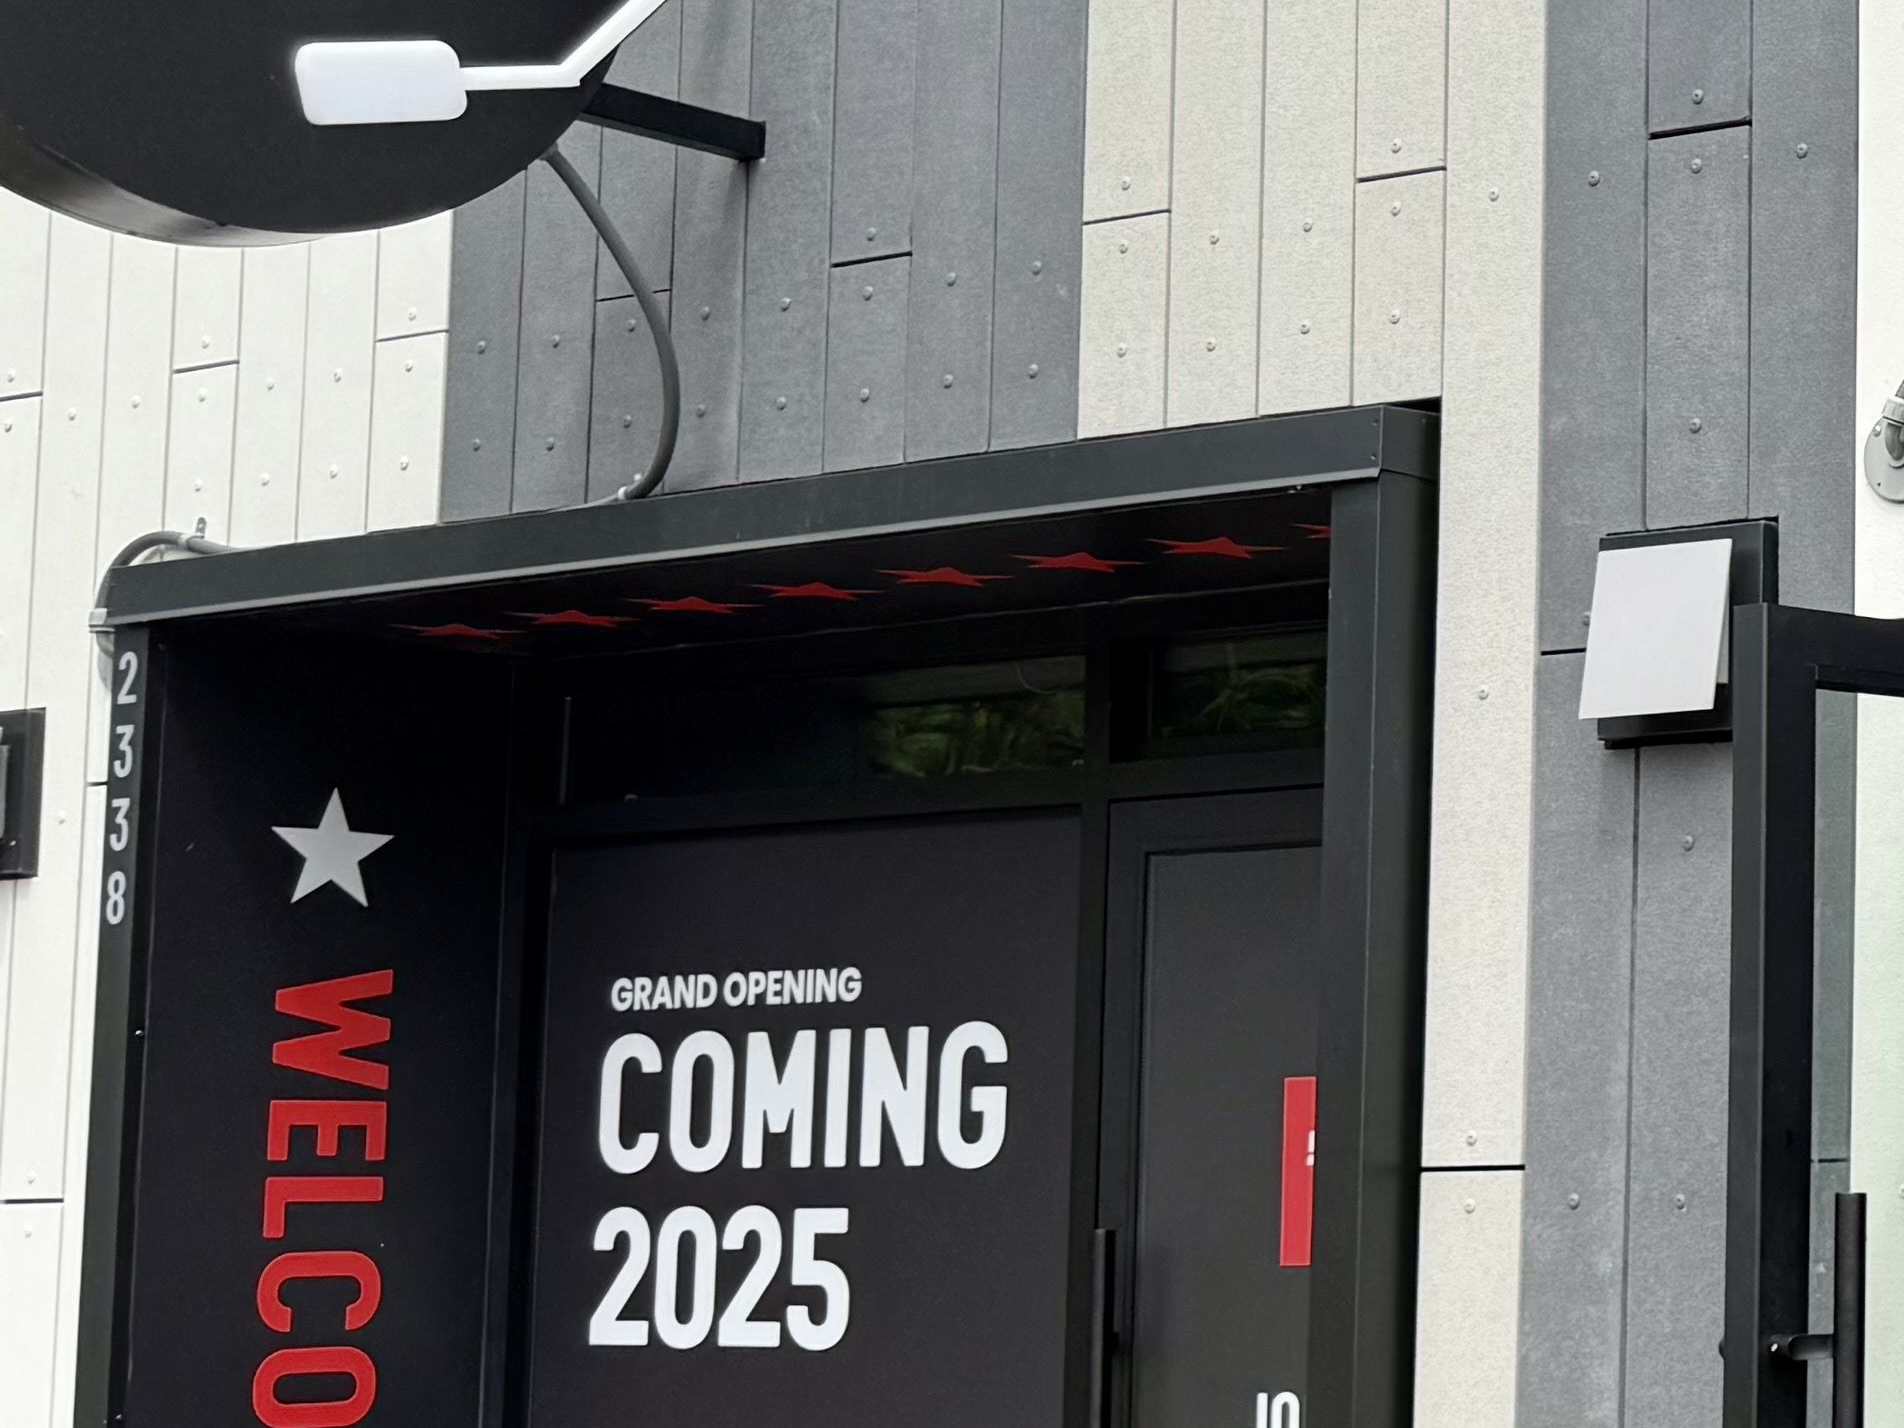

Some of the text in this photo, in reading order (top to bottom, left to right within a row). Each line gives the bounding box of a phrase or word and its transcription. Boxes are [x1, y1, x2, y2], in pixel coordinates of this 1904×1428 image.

[104, 650, 139, 925] 2338
[610, 966, 863, 1012] GRAND OPENING
[598, 1020, 1009, 1176] COMING
[588, 1204, 851, 1353] 2025
